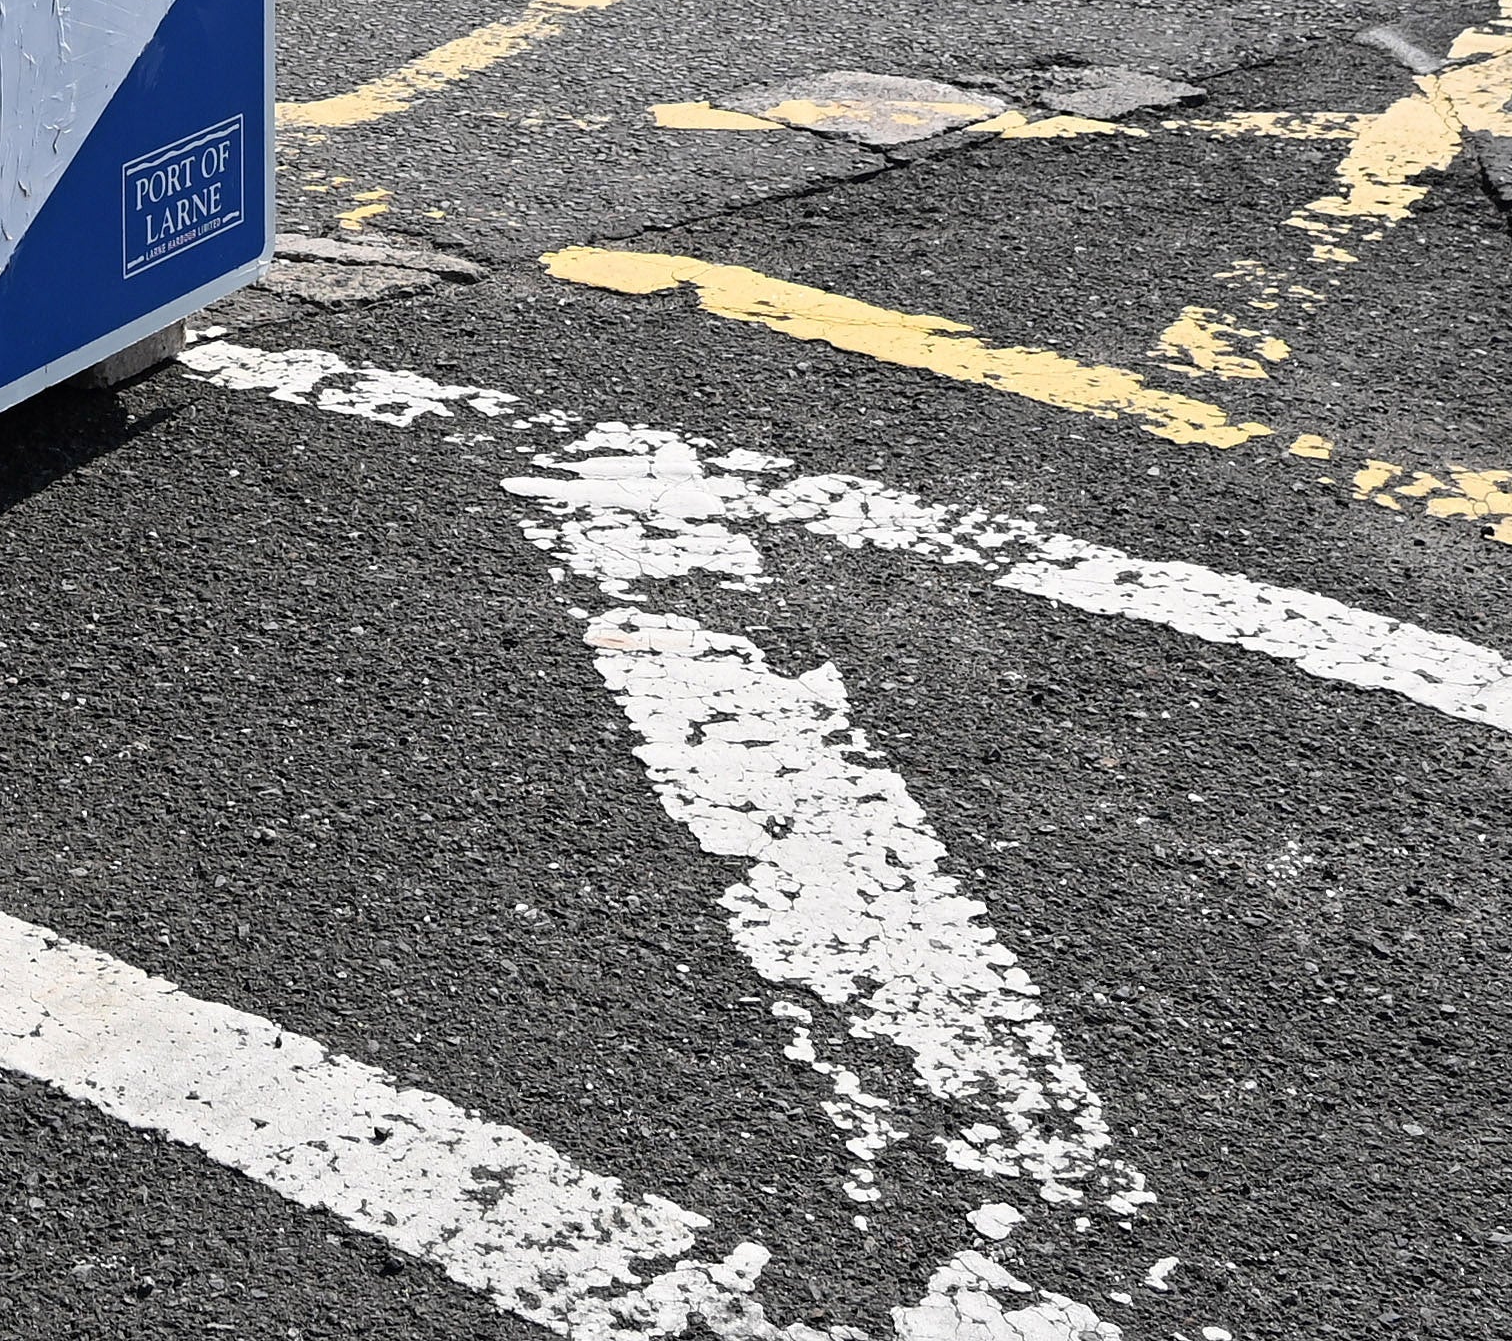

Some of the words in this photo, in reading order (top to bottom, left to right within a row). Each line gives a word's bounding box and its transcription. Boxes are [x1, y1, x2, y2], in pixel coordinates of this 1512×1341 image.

[135, 156, 195, 211] PORT
[201, 140, 231, 179] OF
[145, 182, 222, 245] LARNE
[145, 243, 166, 261] LARNE
[167, 229, 197, 249] HARBOUR
[197, 217, 221, 236] LIMITED
